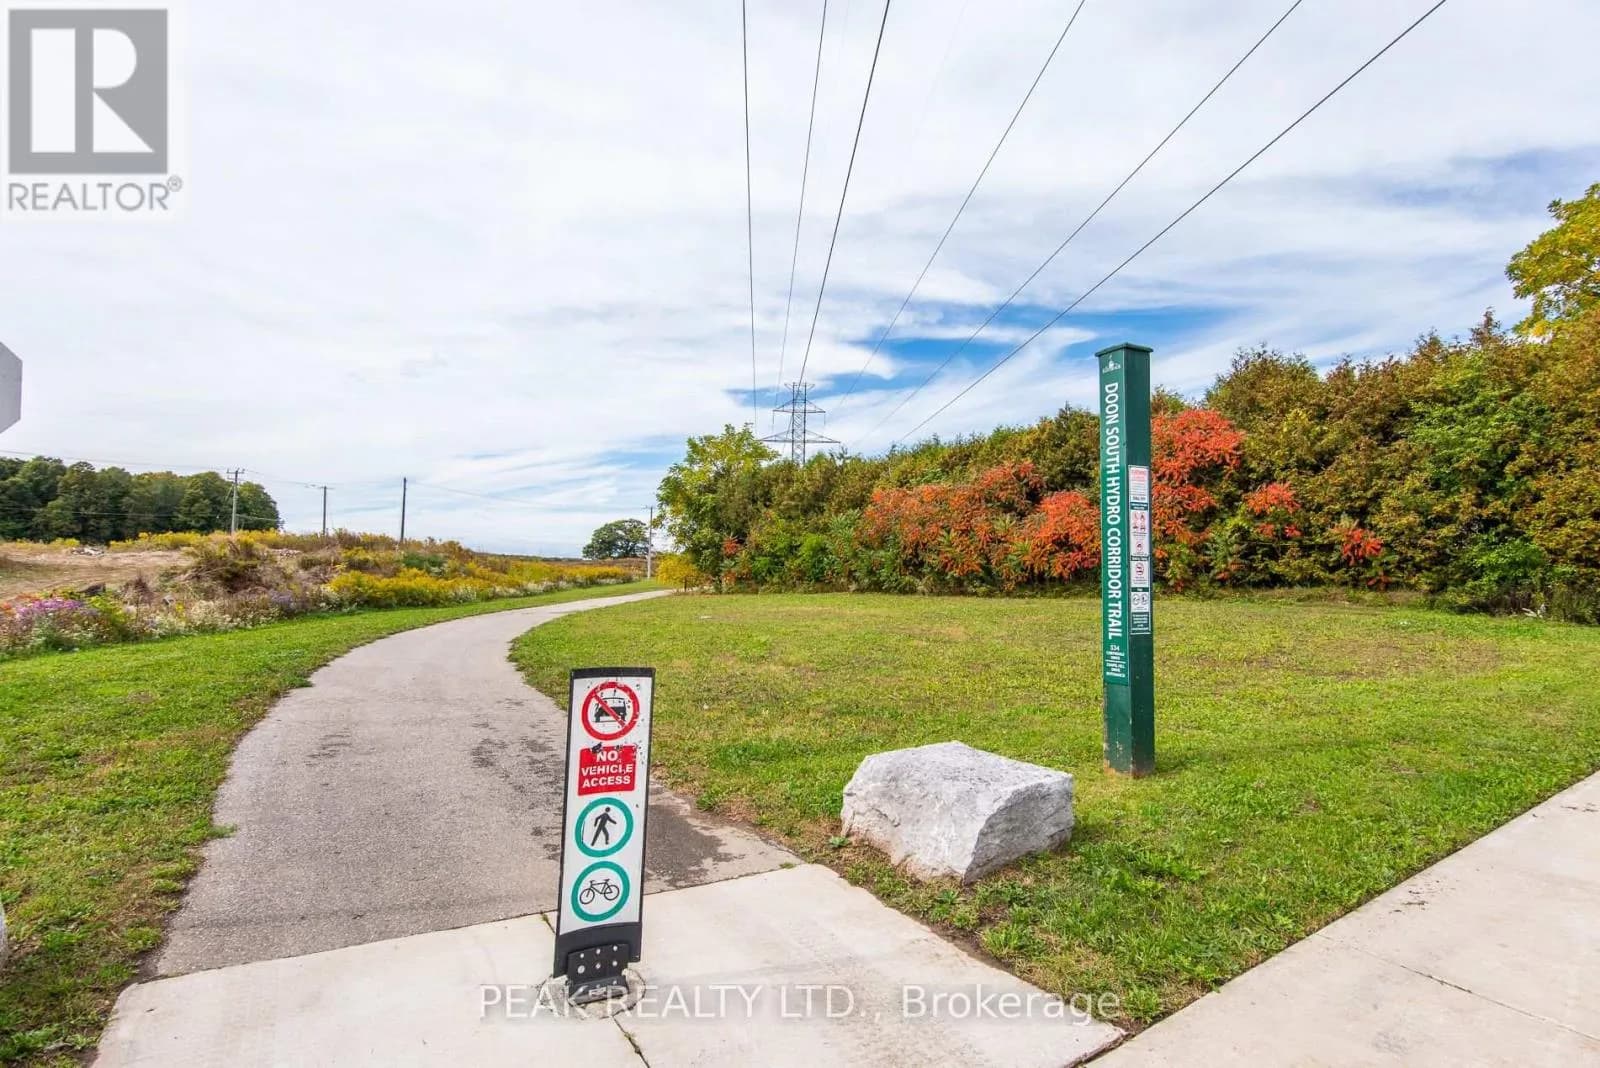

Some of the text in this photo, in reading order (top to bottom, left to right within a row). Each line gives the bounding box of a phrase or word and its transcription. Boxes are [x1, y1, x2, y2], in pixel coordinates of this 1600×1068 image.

[1105, 382, 1119, 424] DOON
[1105, 429, 1120, 474] SOUTH
[1106, 478, 1121, 525] HYDRO
[1107, 531, 1122, 599] CORRIDOR
[1108, 601, 1123, 640] TRAIL
[581, 764, 633, 776] VEHICLE
[596, 750, 618, 763] NO
[582, 775, 631, 788] ACCESS
